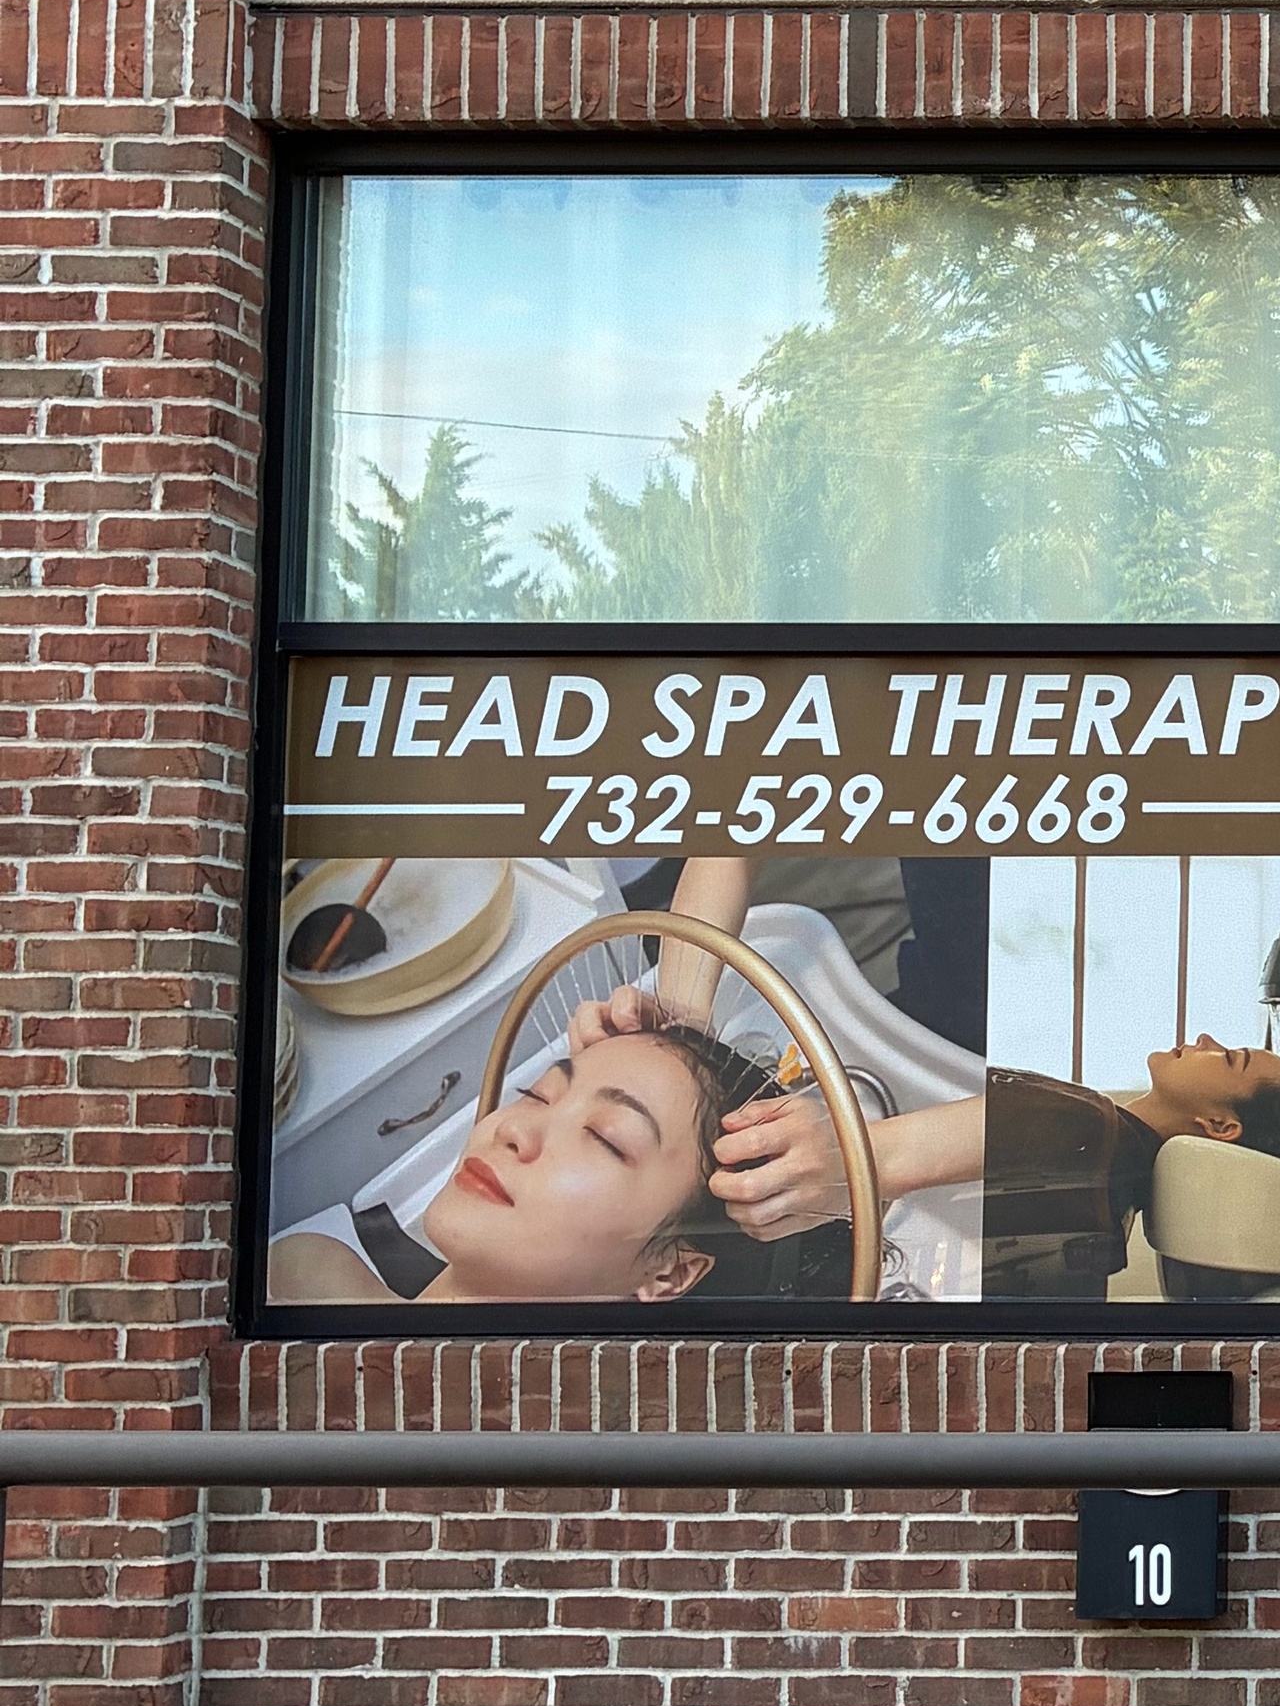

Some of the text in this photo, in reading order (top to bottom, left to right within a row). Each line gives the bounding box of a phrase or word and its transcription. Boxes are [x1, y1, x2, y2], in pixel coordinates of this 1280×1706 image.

[315, 675, 610, 757] HEAD
[641, 673, 841, 759] SPA
[539, 773, 1129, 845] 732-529-6668
[1128, 1543, 1172, 1606] 10
